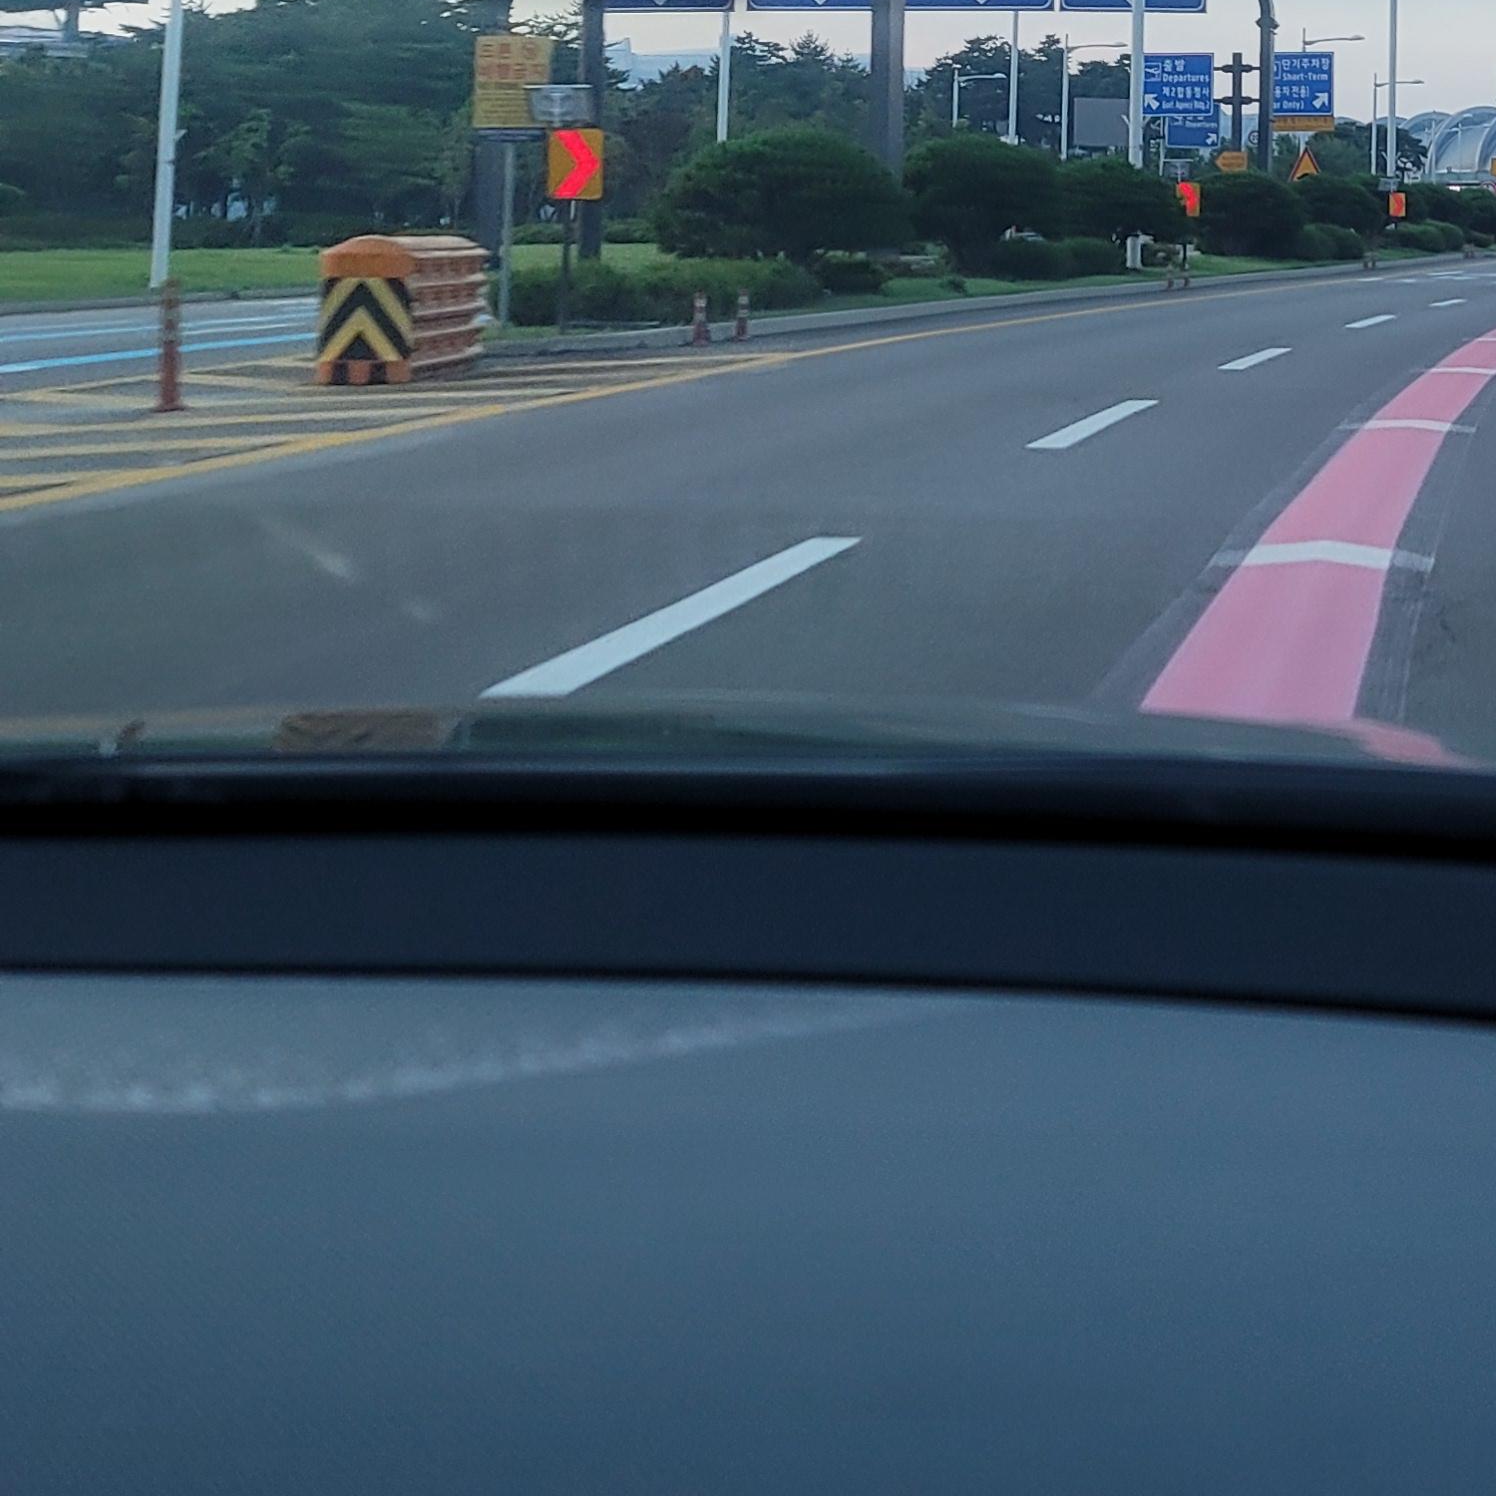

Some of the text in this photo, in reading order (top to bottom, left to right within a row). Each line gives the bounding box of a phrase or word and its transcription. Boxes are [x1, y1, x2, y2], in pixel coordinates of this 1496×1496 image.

[1281, 58, 1330, 70] 단기주차장
[1162, 74, 1210, 83] Departures
[1282, 72, 1328, 81] Short-Term
